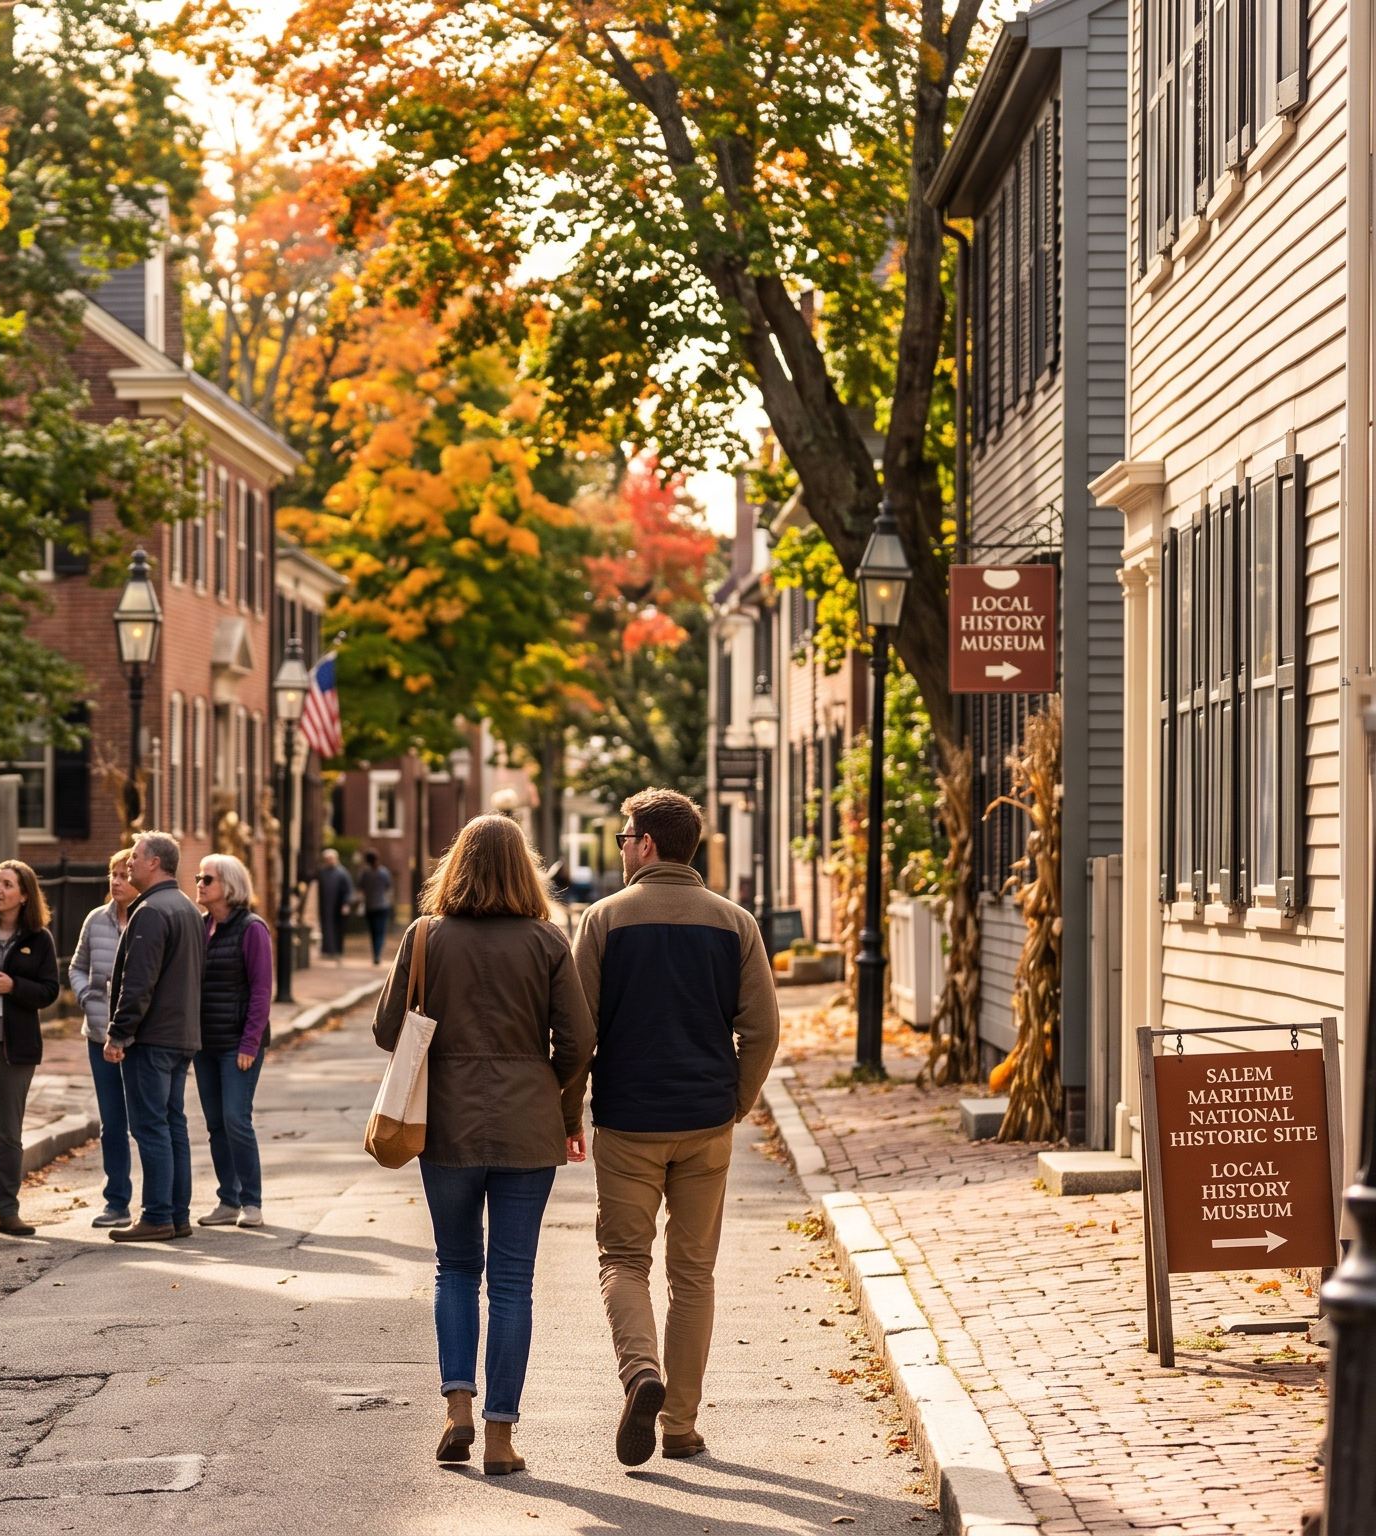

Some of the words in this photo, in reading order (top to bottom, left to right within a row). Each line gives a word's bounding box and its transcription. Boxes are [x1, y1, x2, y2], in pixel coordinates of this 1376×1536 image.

[971, 595, 1033, 612] LOCAL
[960, 615, 1046, 632] HISTORY
[960, 635, 1046, 651] MUSEUM
[1206, 1066, 1274, 1084] SALEM
[1187, 1085, 1294, 1105] MARITIME
[1189, 1106, 1295, 1126] NATIONAL
[1169, 1128, 1268, 1147] HISTORIC
[1273, 1125, 1318, 1143] SITE
[1210, 1161, 1279, 1179] LOCAL
[1201, 1180, 1291, 1200] HISTORY
[1201, 1202, 1293, 1221] MUSEUM
